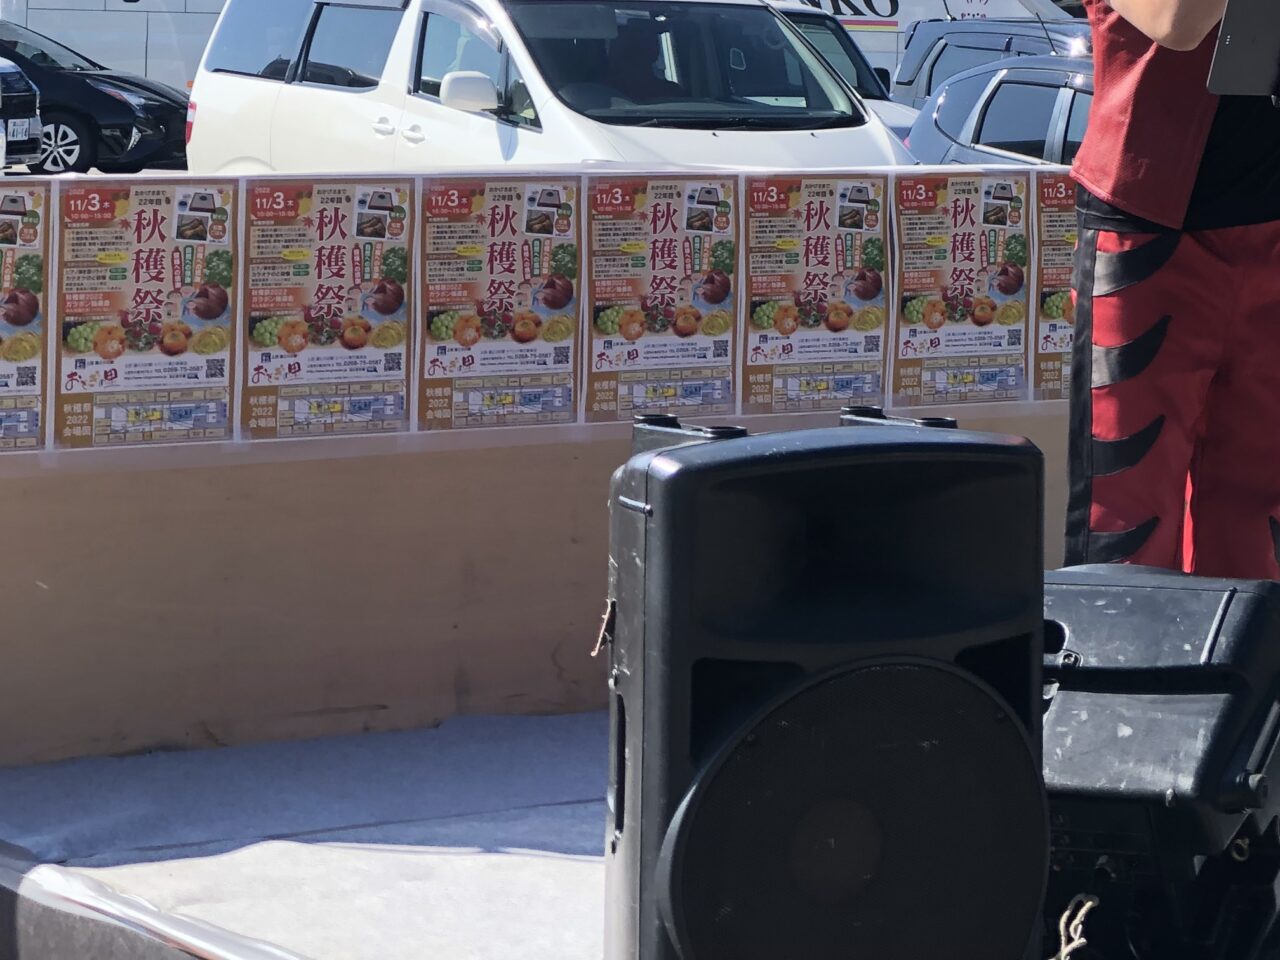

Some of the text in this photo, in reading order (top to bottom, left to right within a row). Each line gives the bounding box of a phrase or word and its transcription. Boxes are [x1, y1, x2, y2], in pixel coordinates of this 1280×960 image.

[430, 189, 458, 206] 11/3
[596, 187, 622, 204] 11/3
[752, 186, 777, 202] 11/3
[902, 184, 925, 200] 11/3
[1044, 182, 1065, 197] 11/3
[68, 193, 100, 211] 11/3
[255, 191, 284, 209] 11/3
[648, 201, 678, 306] 秋穫祭
[802, 199, 830, 301] 秋穫祭
[949, 197, 976, 296] 秋穫祭
[130, 208, 167, 322] 秋穫祭
[313, 206, 347, 317] 秋穫祭
[485, 203, 517, 311] 秋穫祭
[595, 392, 614, 400] 2022
[751, 385, 769, 393] 2022
[251, 407, 273, 416] 2022
[428, 399, 448, 407] 2022
[65, 416, 88, 424] 2022
